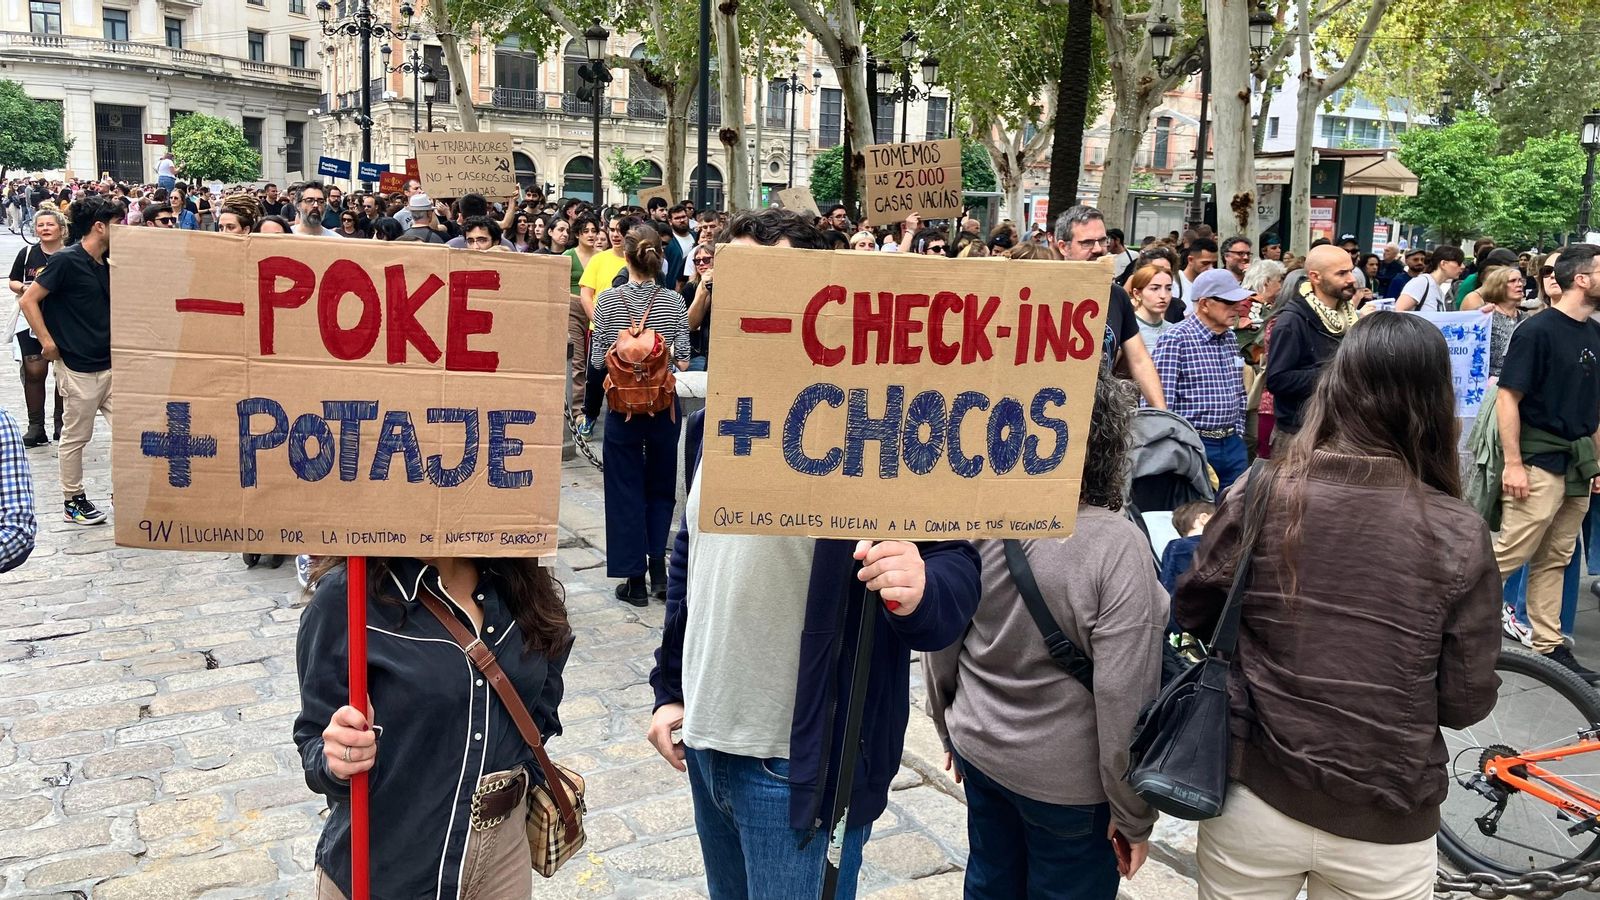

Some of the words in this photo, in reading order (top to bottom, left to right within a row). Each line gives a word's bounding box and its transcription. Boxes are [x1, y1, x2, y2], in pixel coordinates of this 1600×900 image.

[417, 139, 429, 151] NO
[440, 141, 509, 153] TRABAJADORES
[870, 143, 941, 168] TOMEMOS
[436, 155, 456, 165] SIN
[463, 154, 491, 165] CASA
[425, 172, 442, 183] NO
[457, 171, 500, 183] CASEROS
[501, 174, 515, 183] SIN
[874, 173, 889, 186] LAS
[893, 167, 945, 189] 25.000
[874, 193, 913, 213] CASAS
[918, 186, 959, 209] VACÍAS
[257, 256, 501, 372] POKE
[236, 397, 537, 489] POTAJE
[781, 383, 1069, 480] CHOCOS
[713, 506, 744, 527] QUE
[750, 511, 773, 526] LAS
[780, 513, 823, 528] CALLES
[830, 516, 878, 530] HUELAN
[888, 520, 897, 531] A
[903, 519, 917, 531] LA
[967, 521, 981, 531] DE
[986, 519, 1004, 530] TUS
[280, 528, 305, 544] POR
[321, 530, 338, 544] LA
[420, 533, 434, 543] DE
[445, 531, 495, 544] NUESTROS
